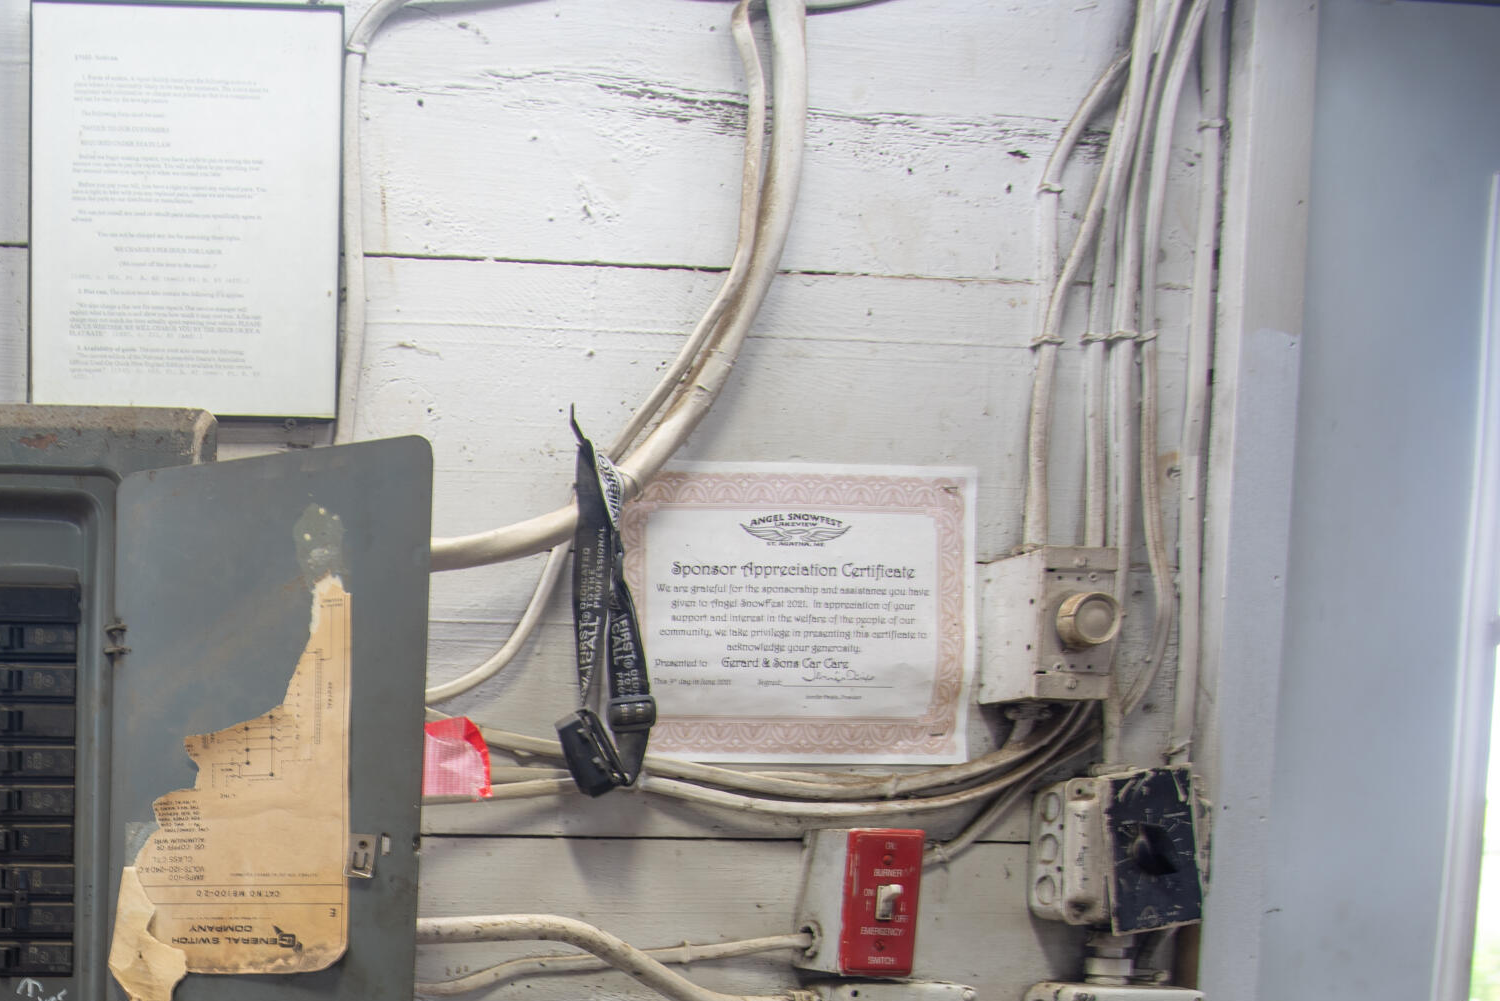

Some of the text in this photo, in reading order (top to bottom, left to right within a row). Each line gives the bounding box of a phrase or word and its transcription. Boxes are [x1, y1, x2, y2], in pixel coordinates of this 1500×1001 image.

[750, 513, 843, 528] ANGEL SNOWFEST
[671, 561, 917, 580] Sponsor Appreciation Certificate
[656, 584, 931, 597] We are grateful for the sponsorship and assistance you have
[671, 599, 696, 609] given
[698, 599, 708, 607] to
[710, 599, 737, 609] Angel
[823, 601, 880, 610] appreciation
[882, 601, 892, 611] of
[893, 603, 916, 612] your
[671, 613, 916, 626] support and interest in the welfare of the people of our
[586, 616, 601, 662] CALL
[659, 628, 928, 641] community, we take privilege in presenting this certificate to
[611, 624, 624, 666] CALL
[726, 643, 786, 653] acknowledge
[787, 645, 810, 654] your
[654, 659, 708, 668] Presented to
[721, 657, 850, 669] Gerard & Sons Car Care
[873, 868, 903, 877] BURNER
[266, 889, 281, 897] CAT
[189, 925, 253, 933] COMPANY
[860, 927, 904, 936] EMERGENCY
[172, 934, 296, 948] GENERAL SWITCH
[867, 956, 897, 965] SWITCH
